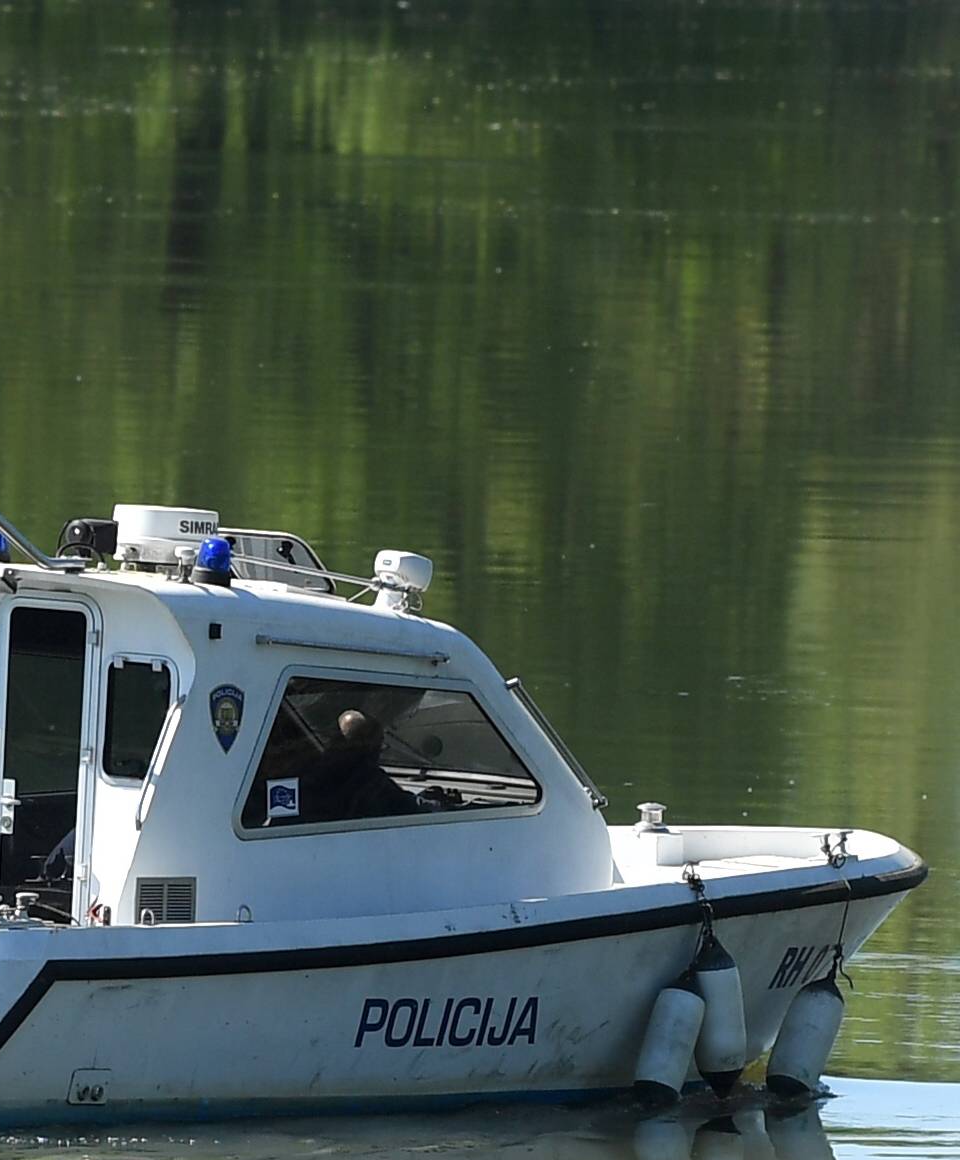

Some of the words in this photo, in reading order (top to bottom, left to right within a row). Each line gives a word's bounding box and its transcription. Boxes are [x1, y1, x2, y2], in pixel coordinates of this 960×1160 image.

[212, 688, 242, 702] POLICIJA
[768, 946, 815, 989] RH
[353, 996, 539, 1048] POLICIJA
